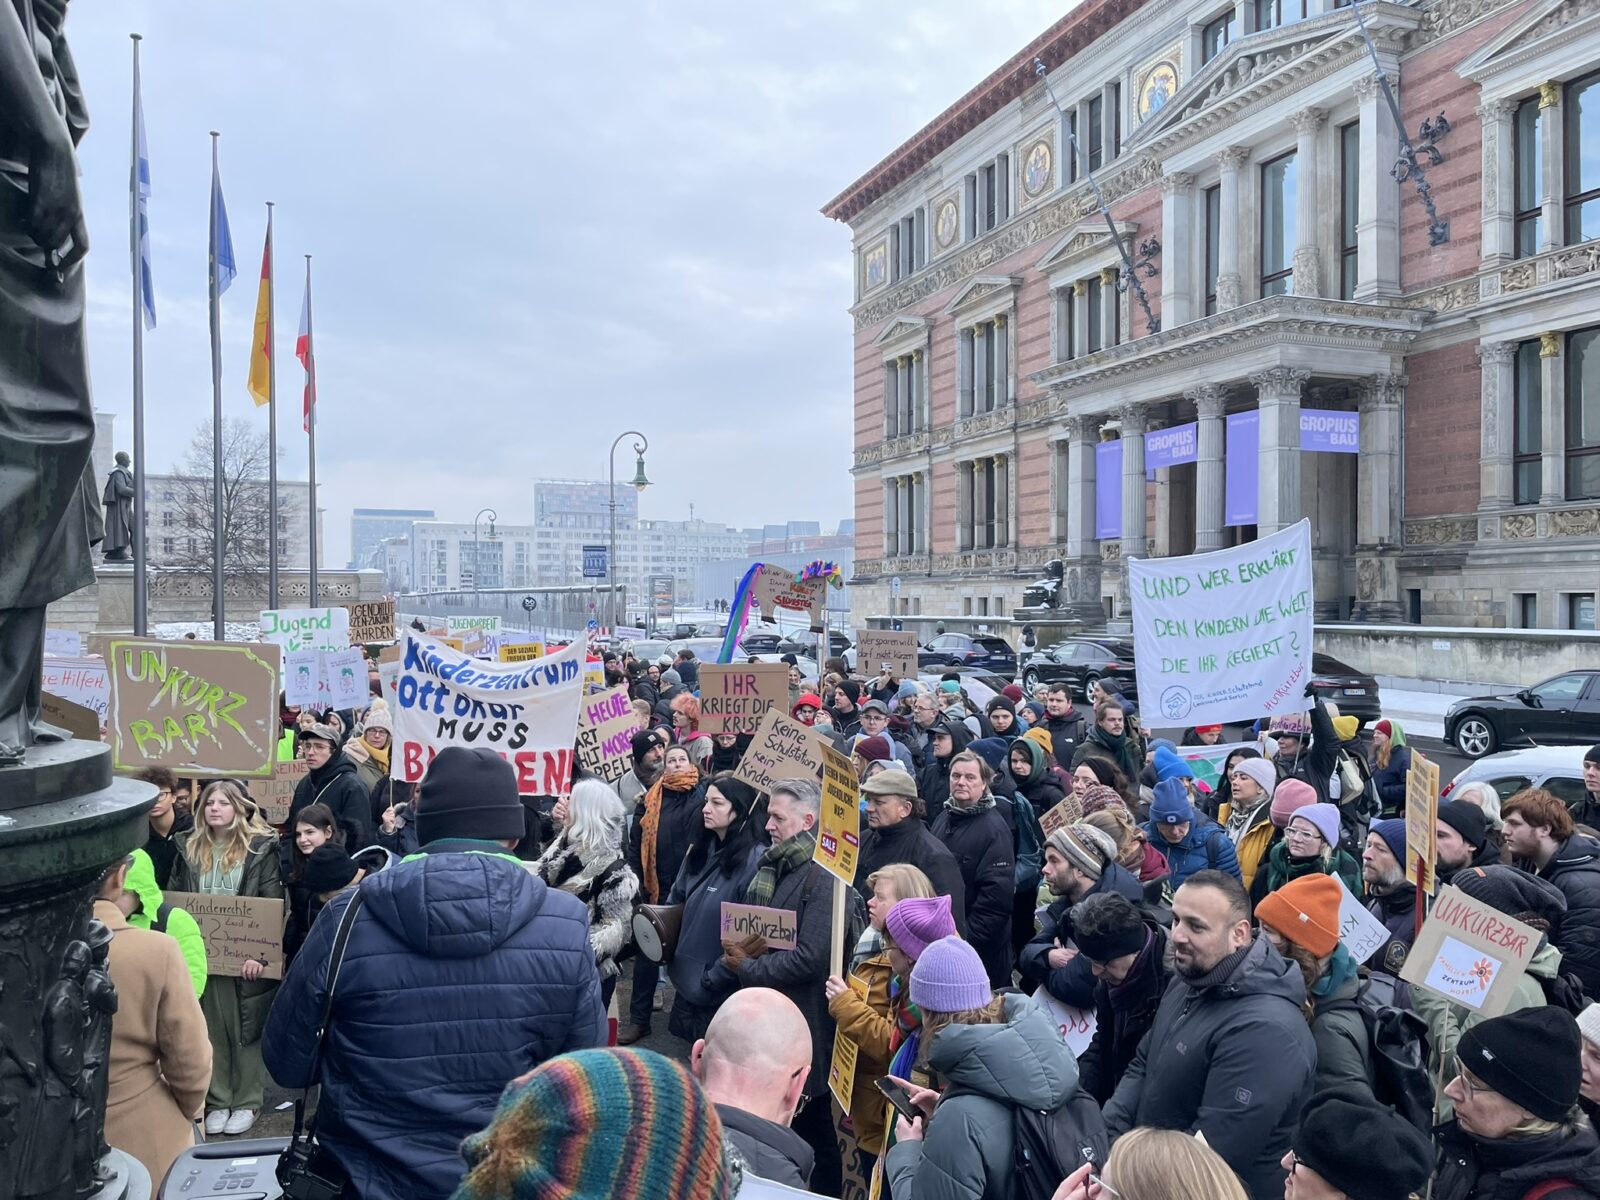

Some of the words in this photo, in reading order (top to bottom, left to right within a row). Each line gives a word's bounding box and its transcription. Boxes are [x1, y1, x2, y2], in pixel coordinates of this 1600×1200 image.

[1300, 415, 1357, 434] GROPIUS
[1330, 433, 1357, 445] BAU
[1148, 430, 1193, 451] GROPIUS
[1172, 444, 1193, 458] BAU
[1143, 576, 1190, 600] UND
[1198, 568, 1233, 590] WER
[1238, 548, 1297, 583] ERKLÄRT
[262, 608, 331, 638] Jugend
[1155, 618, 1188, 638] DEN
[1195, 613, 1249, 638] KINDERN
[1254, 606, 1276, 626] DIE
[858, 632, 874, 645] Wer
[899, 636, 914, 646] will
[858, 648, 873, 658] darf
[876, 650, 891, 658] nicht
[124, 647, 166, 683] UN
[404, 636, 578, 690] Kinderzentrum
[1161, 658, 1190, 674] DIE
[1198, 655, 1219, 675] IHR
[1226, 635, 1285, 669] REGIERT
[724, 674, 759, 695] IHR
[587, 693, 631, 726] HEUTE
[701, 697, 749, 715] KRIEGT
[753, 698, 775, 714] DIE
[129, 713, 222, 759] BAR
[437, 717, 529, 749] MUSS
[576, 728, 597, 748] ART
[771, 716, 806, 744] Keine
[579, 746, 600, 768] HLT
[601, 726, 643, 760] MORG
[764, 733, 817, 770] Schulstation
[594, 754, 634, 783] PPELT
[738, 757, 777, 789] Kinder
[822, 836, 835, 852] SALE
[185, 897, 253, 915] Kinderrechte
[1435, 894, 1529, 958] UNKÜRZBAR
[1442, 975, 1474, 986] ZENTRUM
